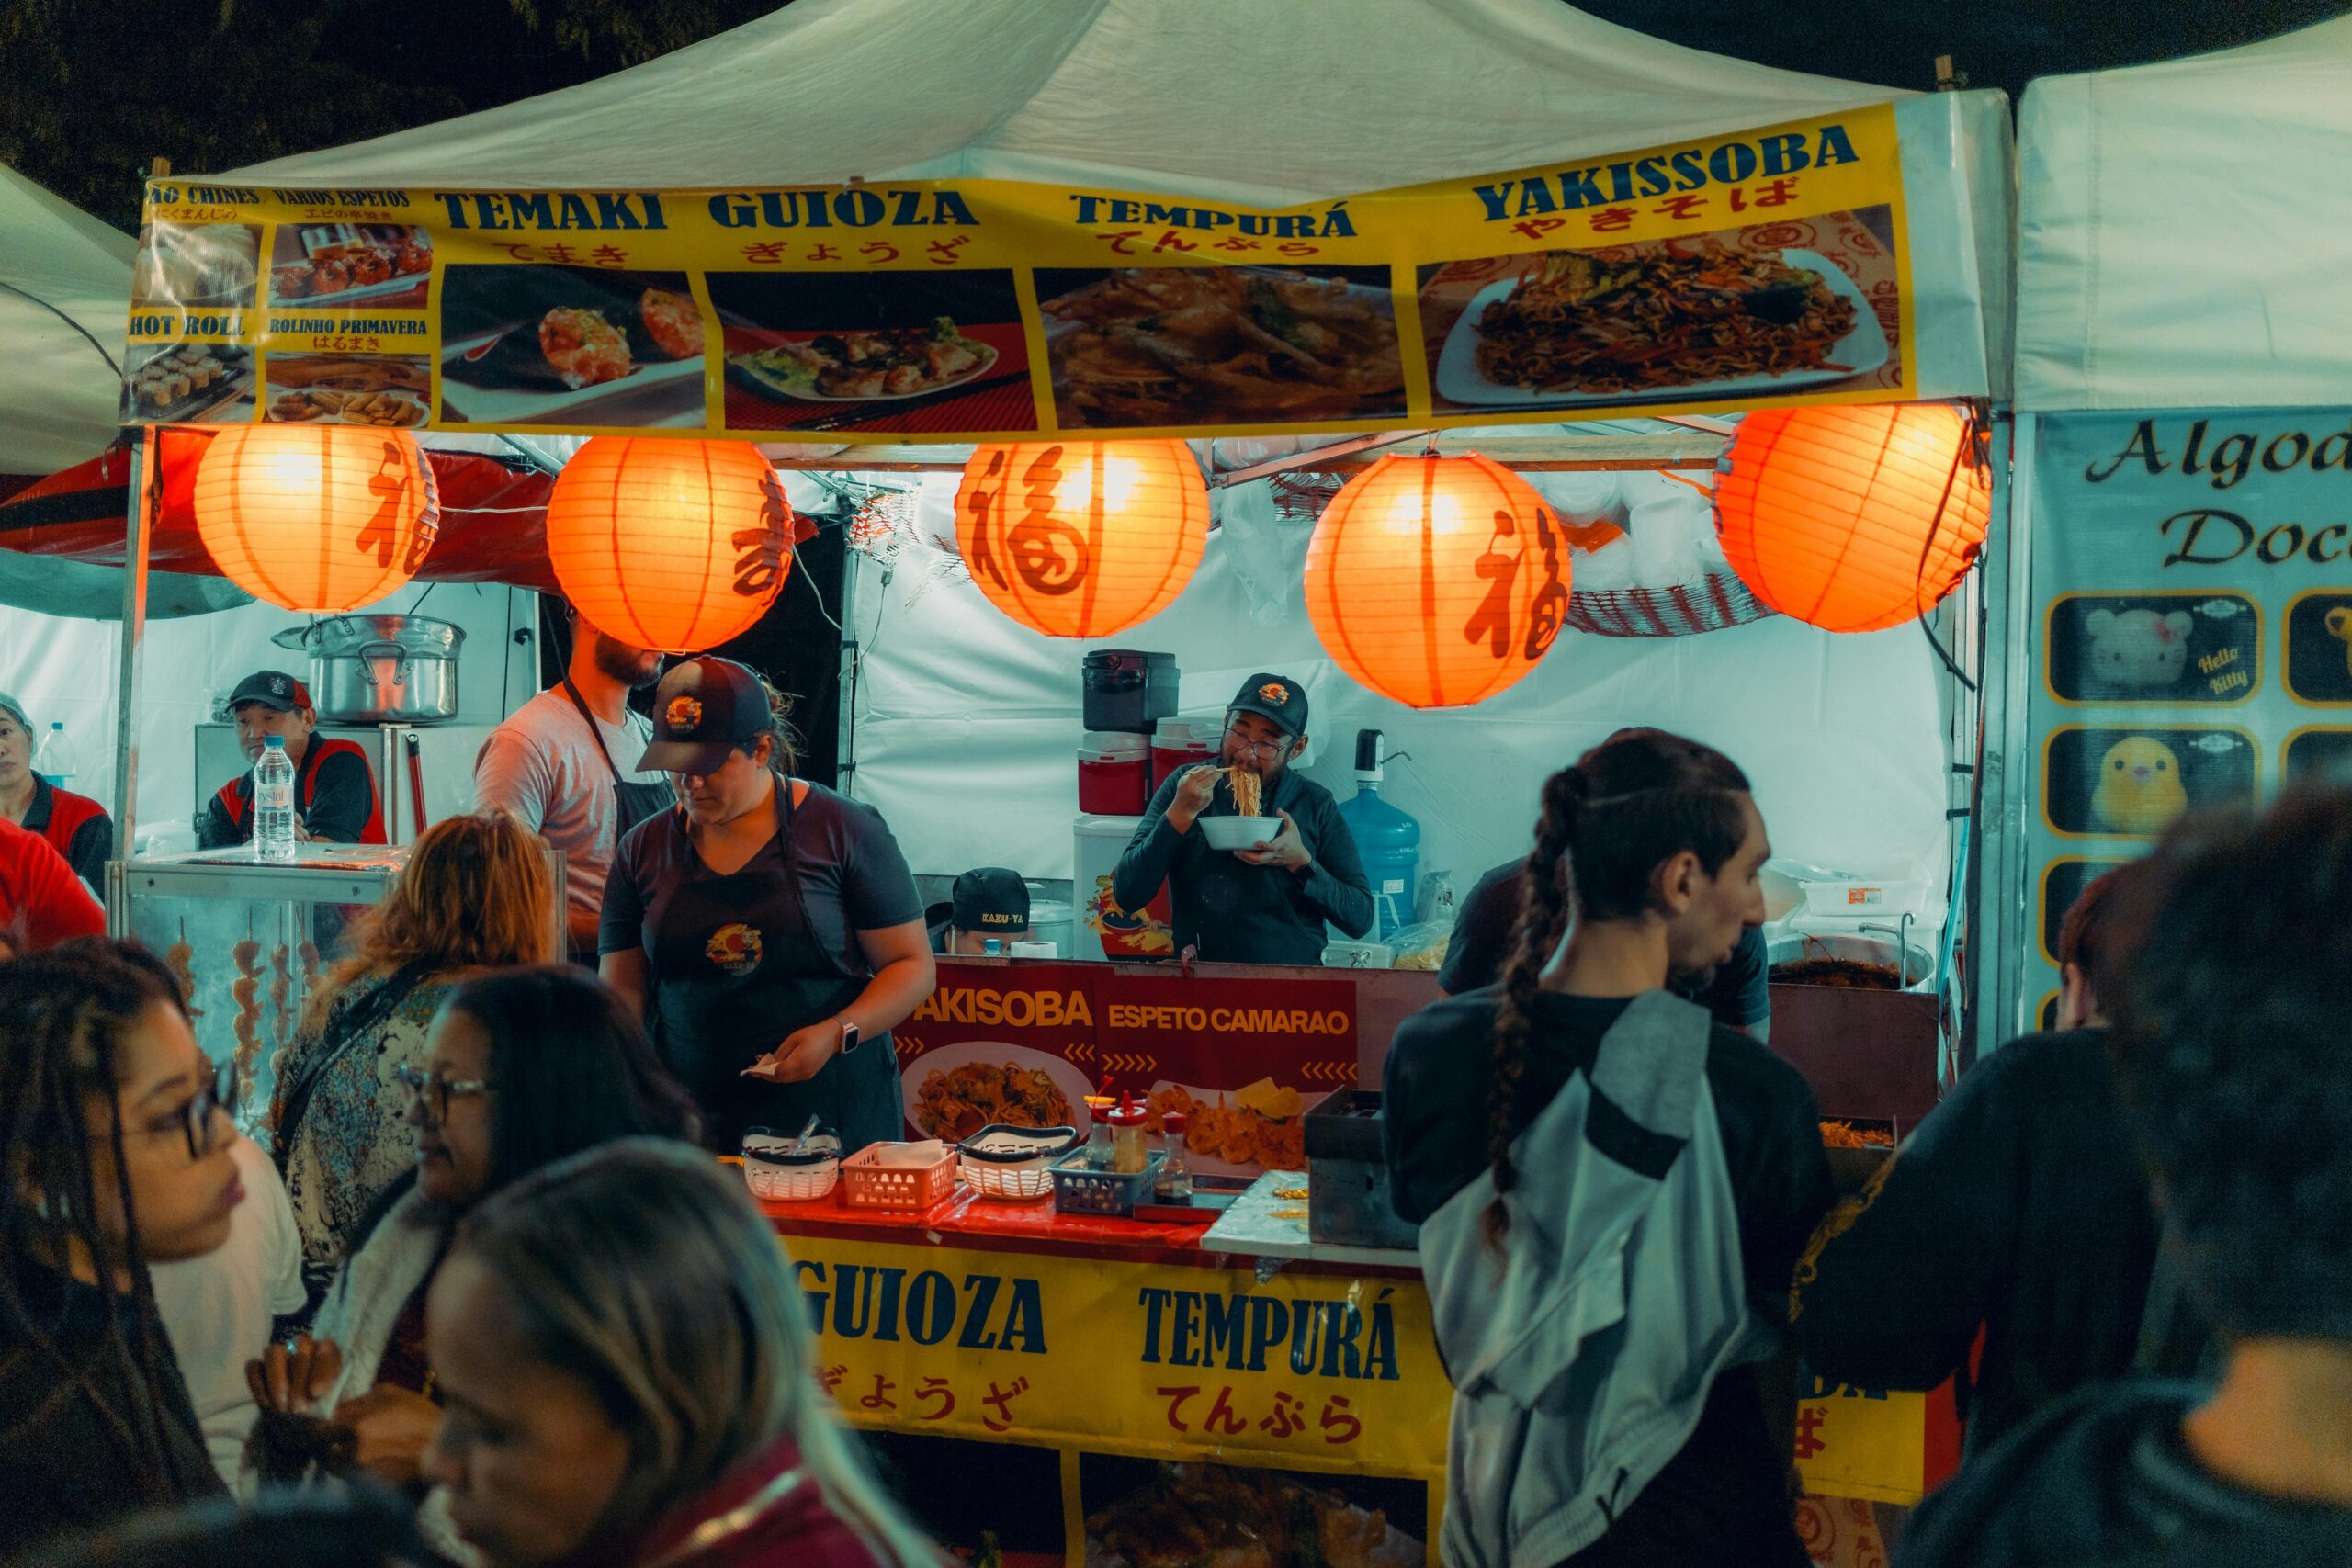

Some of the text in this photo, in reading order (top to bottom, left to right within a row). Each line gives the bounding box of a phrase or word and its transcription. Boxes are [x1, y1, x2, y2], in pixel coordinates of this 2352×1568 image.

[1472, 125, 1860, 221] YAKISSOBA
[337, 189, 410, 208] ESPETOS
[434, 192, 668, 230] TEMAKI
[707, 189, 980, 228] GUIOZA
[1510, 176, 1801, 240] やきそば
[1069, 192, 1358, 238] TEMPURÁ
[492, 243, 629, 269] てまき
[741, 235, 970, 265] ぎょうざ
[130, 315, 245, 335] HOT ROLL
[269, 319, 427, 334] ROLINHO PRIMAVERA
[313, 336, 380, 351] はるまき
[2161, 508, 2352, 568] Doc
[2198, 648, 2239, 674] Hello
[2210, 671, 2248, 695] Kitty
[982, 913, 1023, 924] KAZU-YA
[1108, 1004, 1349, 1035] ESPETO CAMARAO
[792, 1260, 1047, 1354] GUIOZA
[1138, 1287, 1400, 1381] TEMPURÁ
